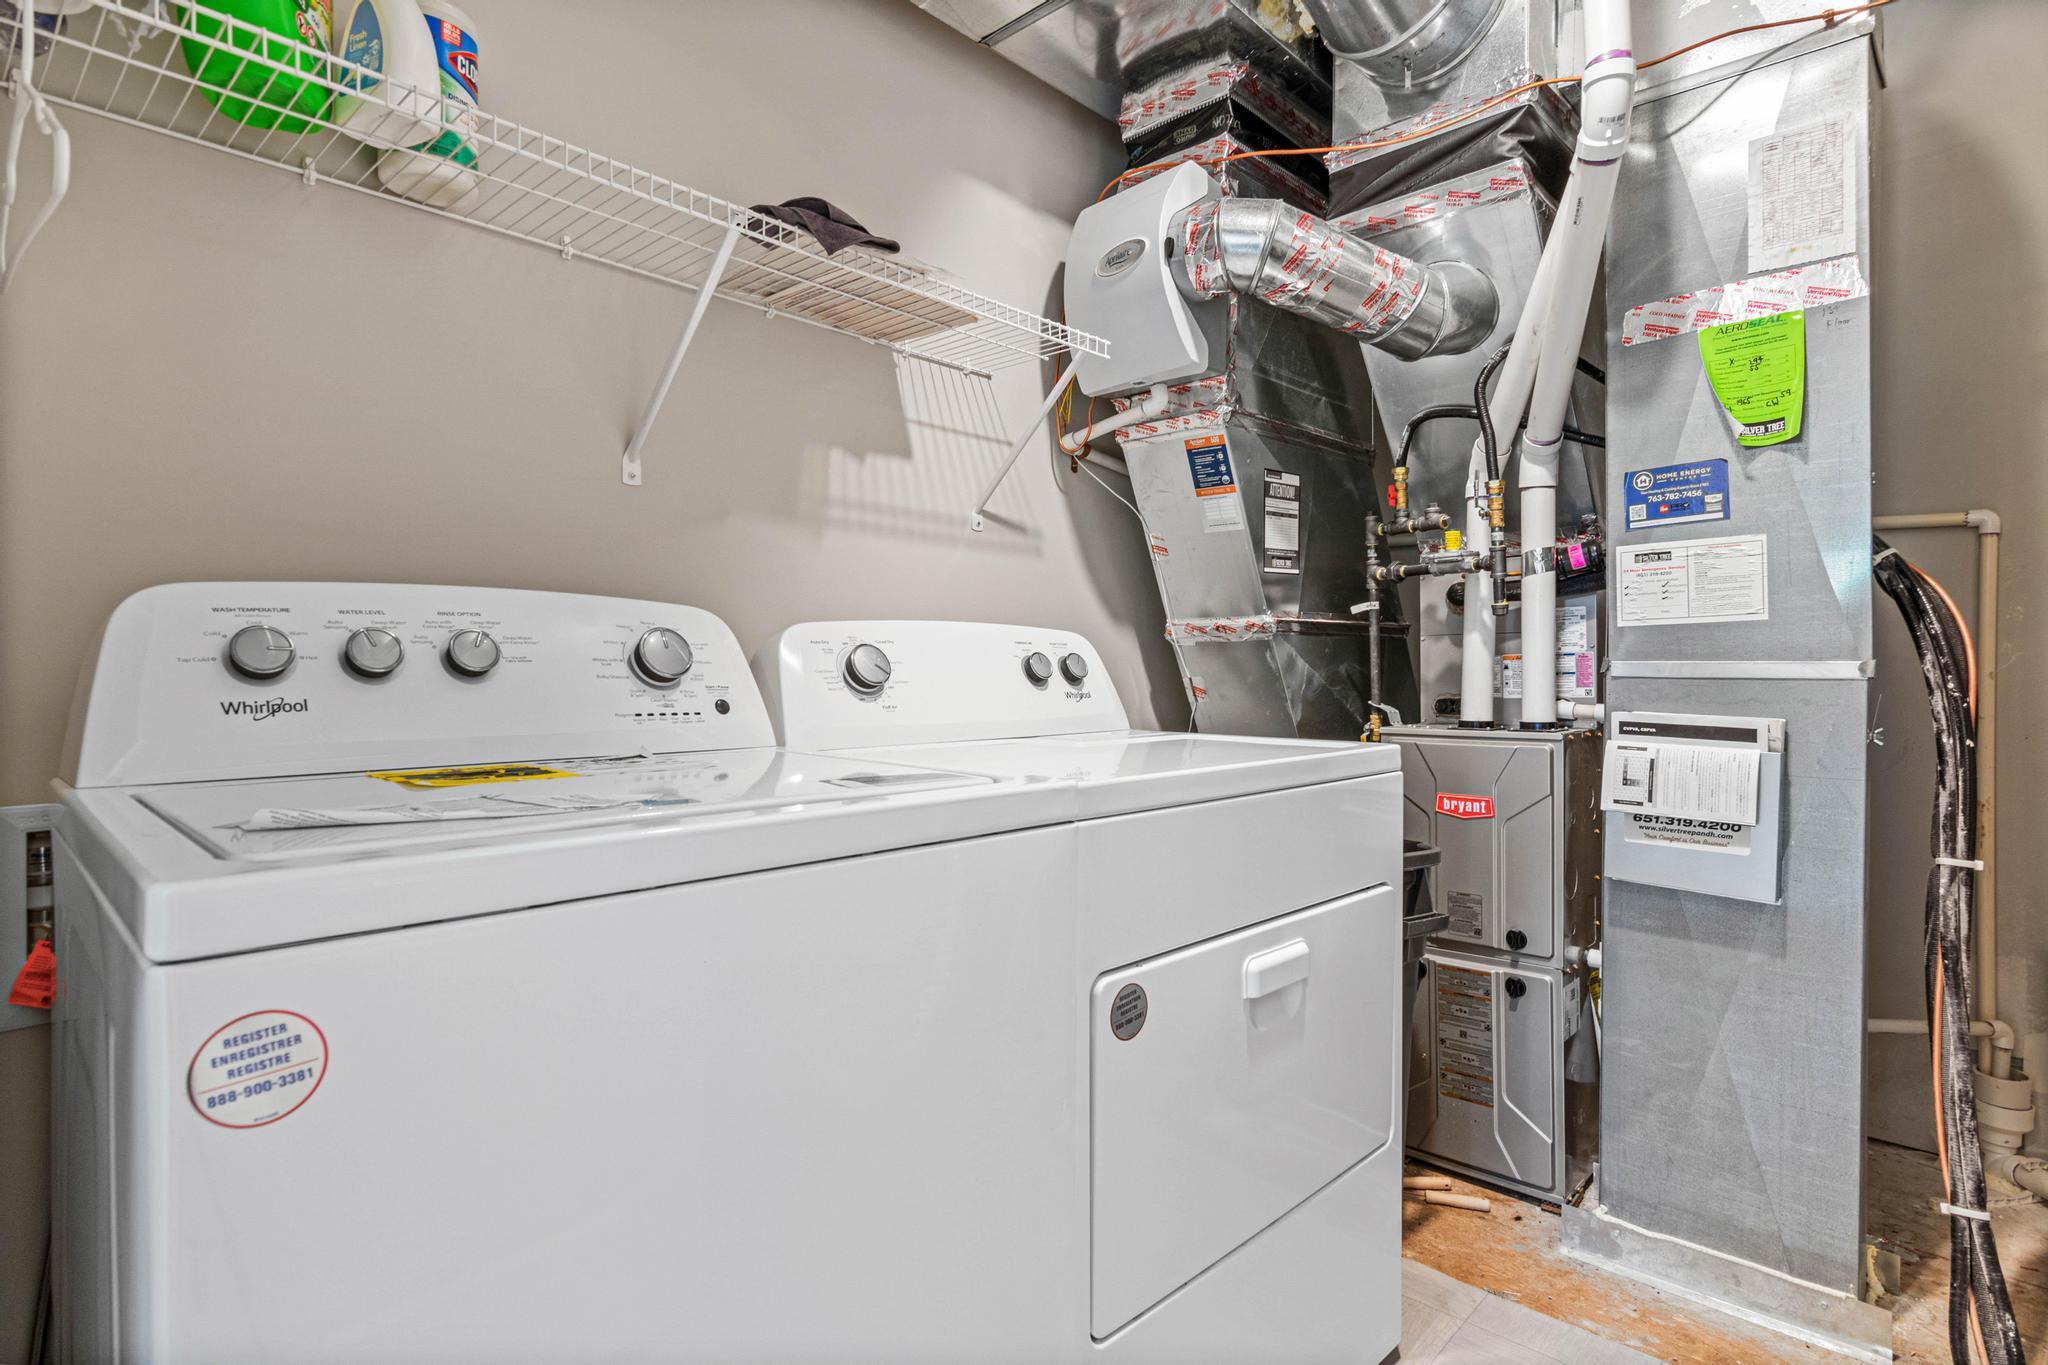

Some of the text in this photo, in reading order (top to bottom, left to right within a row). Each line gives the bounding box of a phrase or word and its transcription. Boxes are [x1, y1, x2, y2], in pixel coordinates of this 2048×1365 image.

[1715, 315, 1784, 336] AEROSEAL
[1767, 420, 1785, 432] TREE
[1656, 467, 1711, 480] HOME ENERGY
[1648, 490, 1702, 503] 763-782-7456
[219, 698, 308, 720] Whirlpool
[1443, 797, 1486, 814] bryant
[1632, 813, 1742, 832] 651.319.4200
[1638, 824, 1734, 840] www.silvertreepandh.com
[223, 1023, 288, 1049] REGISTER
[211, 1034, 302, 1069] ENREGISTRER
[227, 1052, 292, 1080] REGISTRE
[207, 1067, 313, 1109] 888-900-3381
